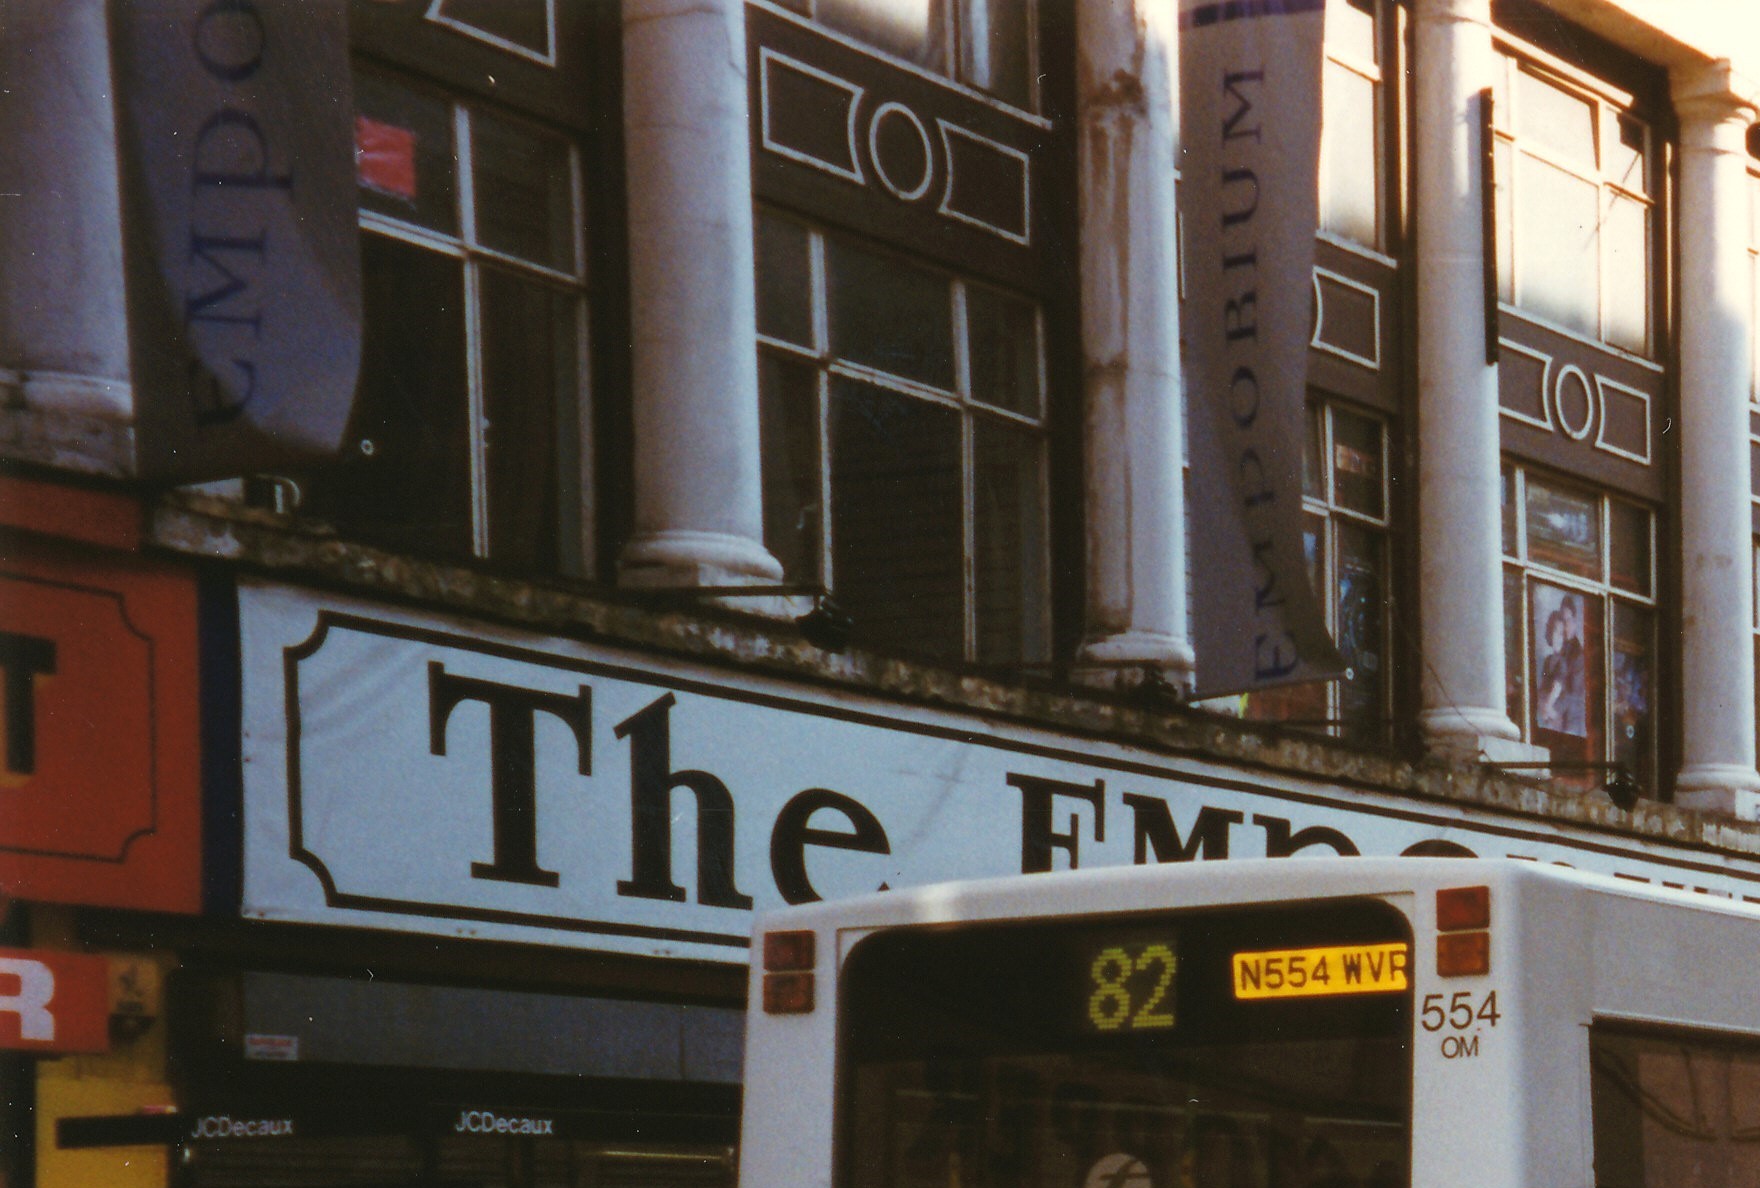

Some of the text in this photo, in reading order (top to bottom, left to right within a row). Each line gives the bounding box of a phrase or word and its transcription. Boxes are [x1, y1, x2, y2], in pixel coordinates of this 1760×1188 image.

[1221, 65, 1300, 685] EMPORIUM
[427, 660, 892, 911] The
[1089, 945, 1177, 1029] 82
[1239, 957, 1331, 991] N554
[1421, 990, 1501, 1032] 554
[1441, 1036, 1479, 1059] OM
[191, 1116, 294, 1138] JCDecaux
[455, 1111, 553, 1135] JCDecaux
